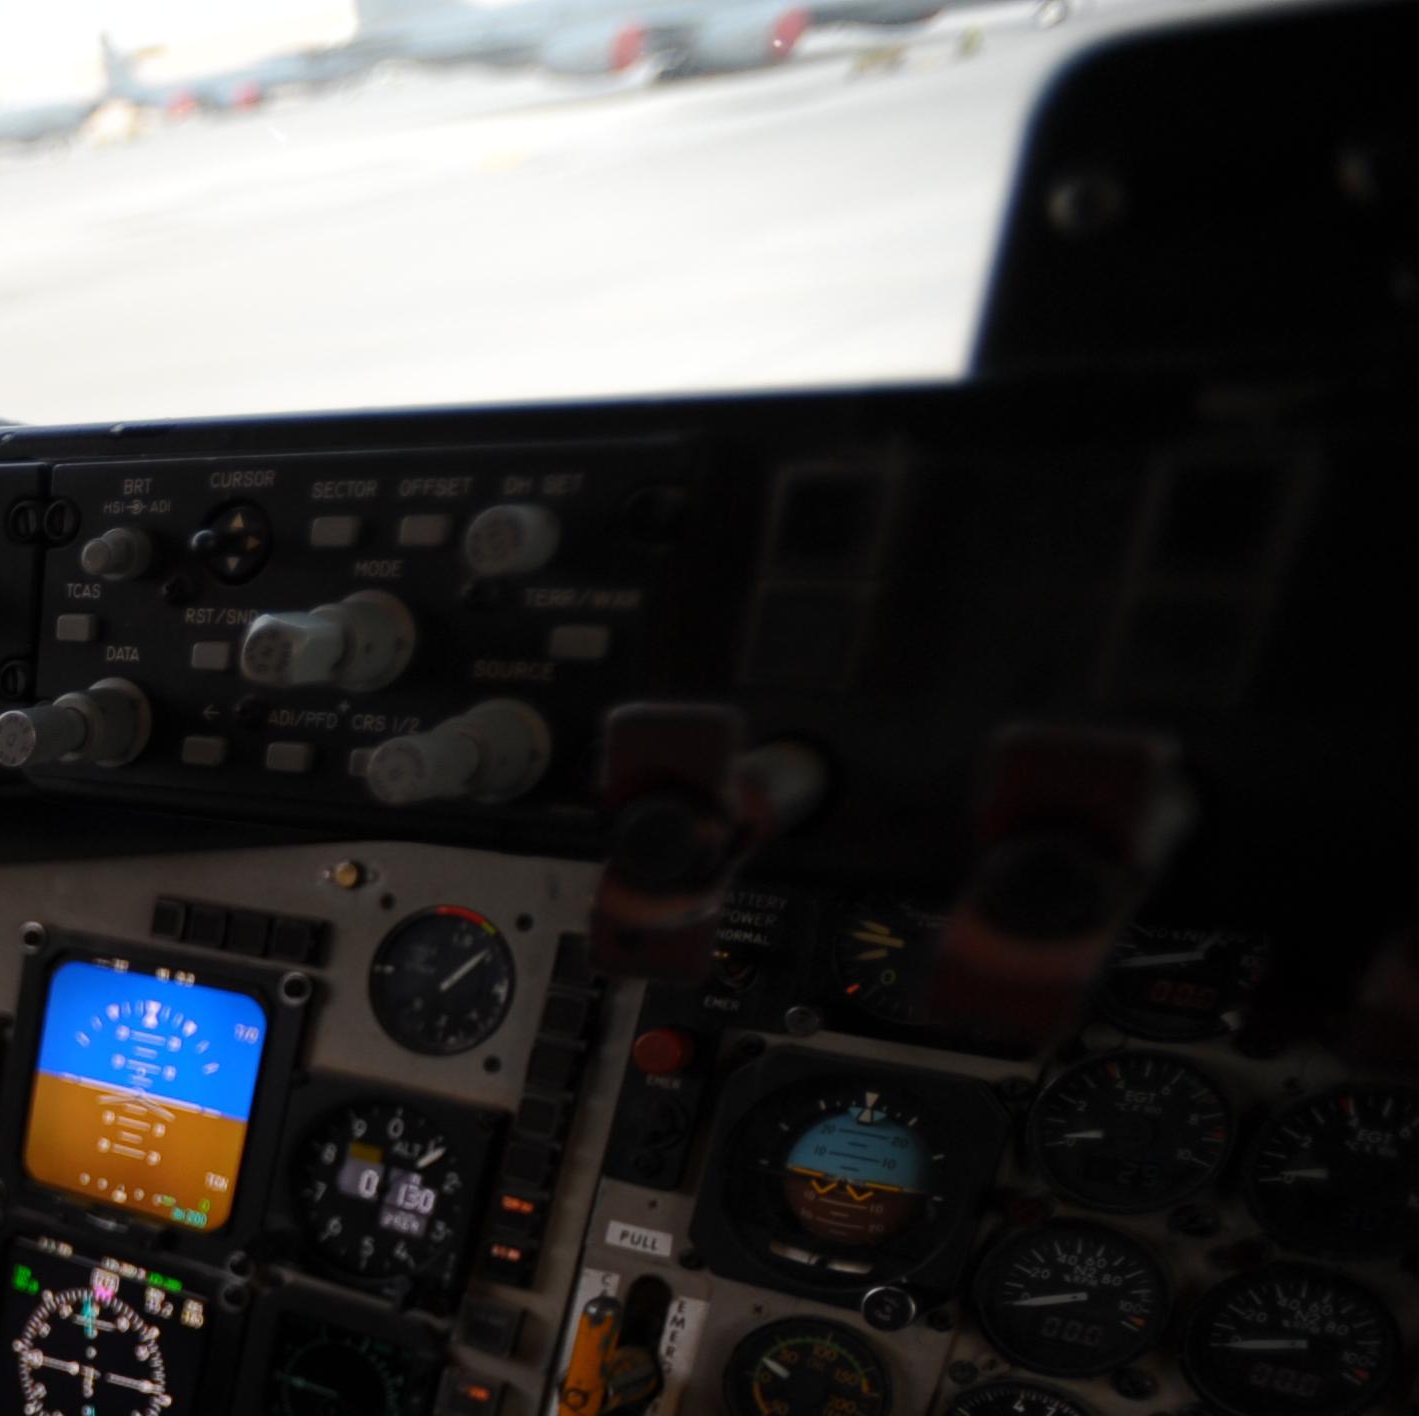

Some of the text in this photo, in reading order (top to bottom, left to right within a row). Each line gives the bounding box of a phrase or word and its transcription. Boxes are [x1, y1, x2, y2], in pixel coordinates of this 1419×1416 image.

[123, 478, 153, 495] BRT
[210, 470, 275, 488] CURSOR
[399, 476, 473, 497] OFFSET
[312, 480, 378, 499] SECTOR
[103, 500, 171, 513] HSI ADI
[354, 559, 403, 578] MODE
[66, 583, 101, 599] TCAS
[106, 646, 139, 663] DATA
[268, 710, 338, 730] ADI/PFD
[352, 714, 385, 732] CRS
[620, 1228, 659, 1251] PULL
